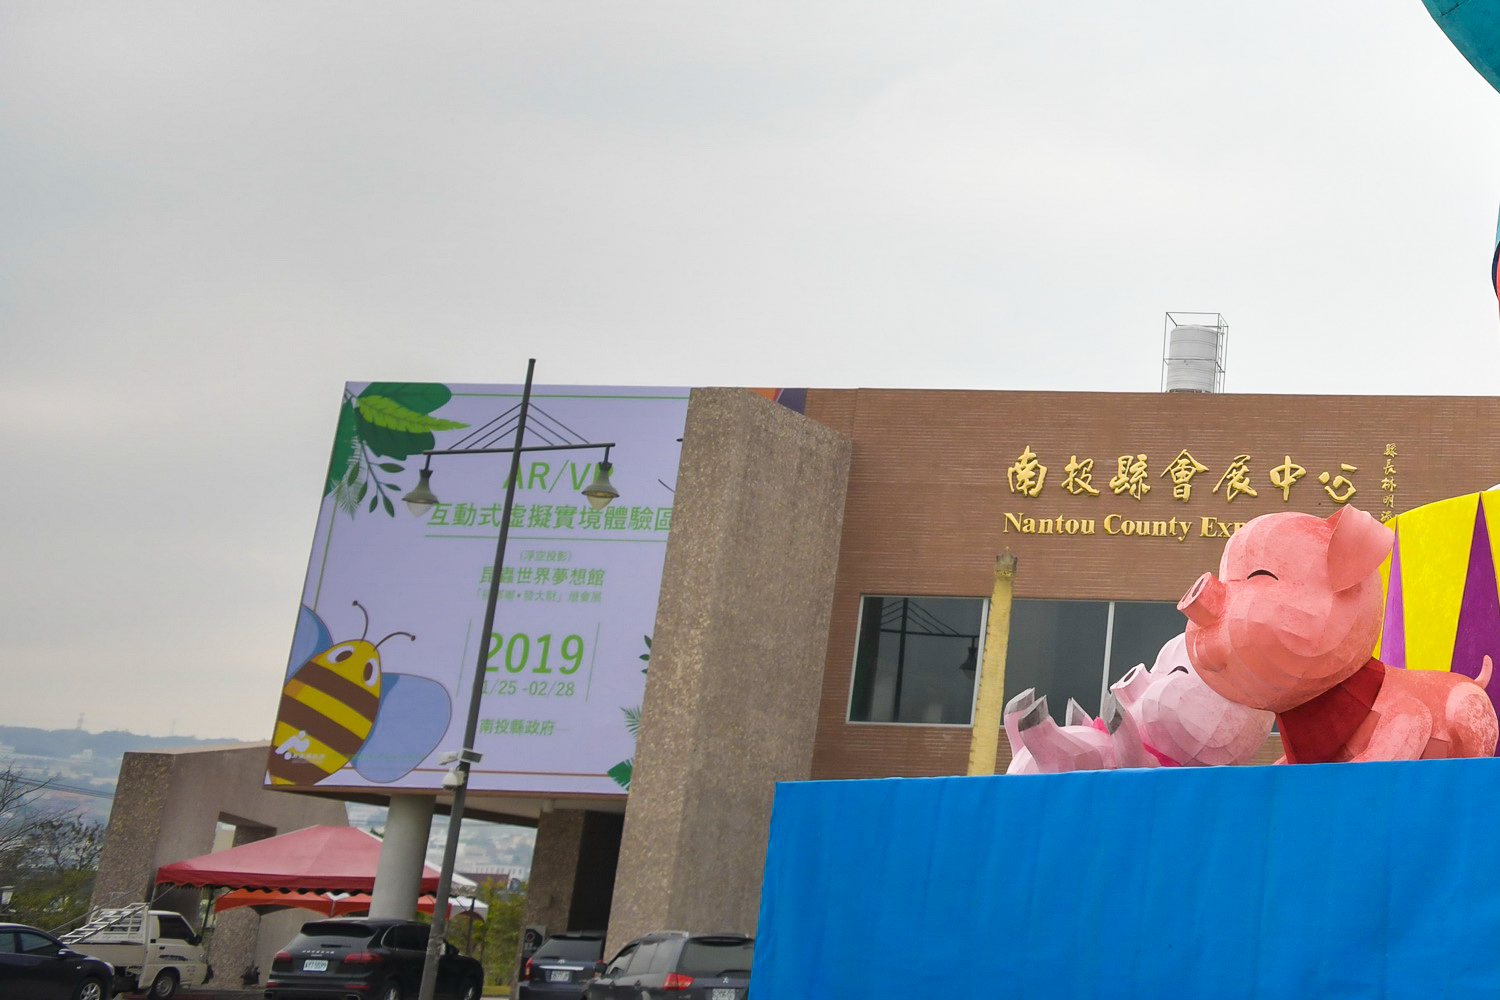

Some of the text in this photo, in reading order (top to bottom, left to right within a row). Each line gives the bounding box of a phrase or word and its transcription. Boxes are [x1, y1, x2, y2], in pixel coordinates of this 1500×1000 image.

[1007, 445, 1358, 503] 南投縣會展中心
[1003, 512, 1096, 537] Nantou
[1104, 514, 1193, 542] County
[484, 632, 584, 675] 2019
